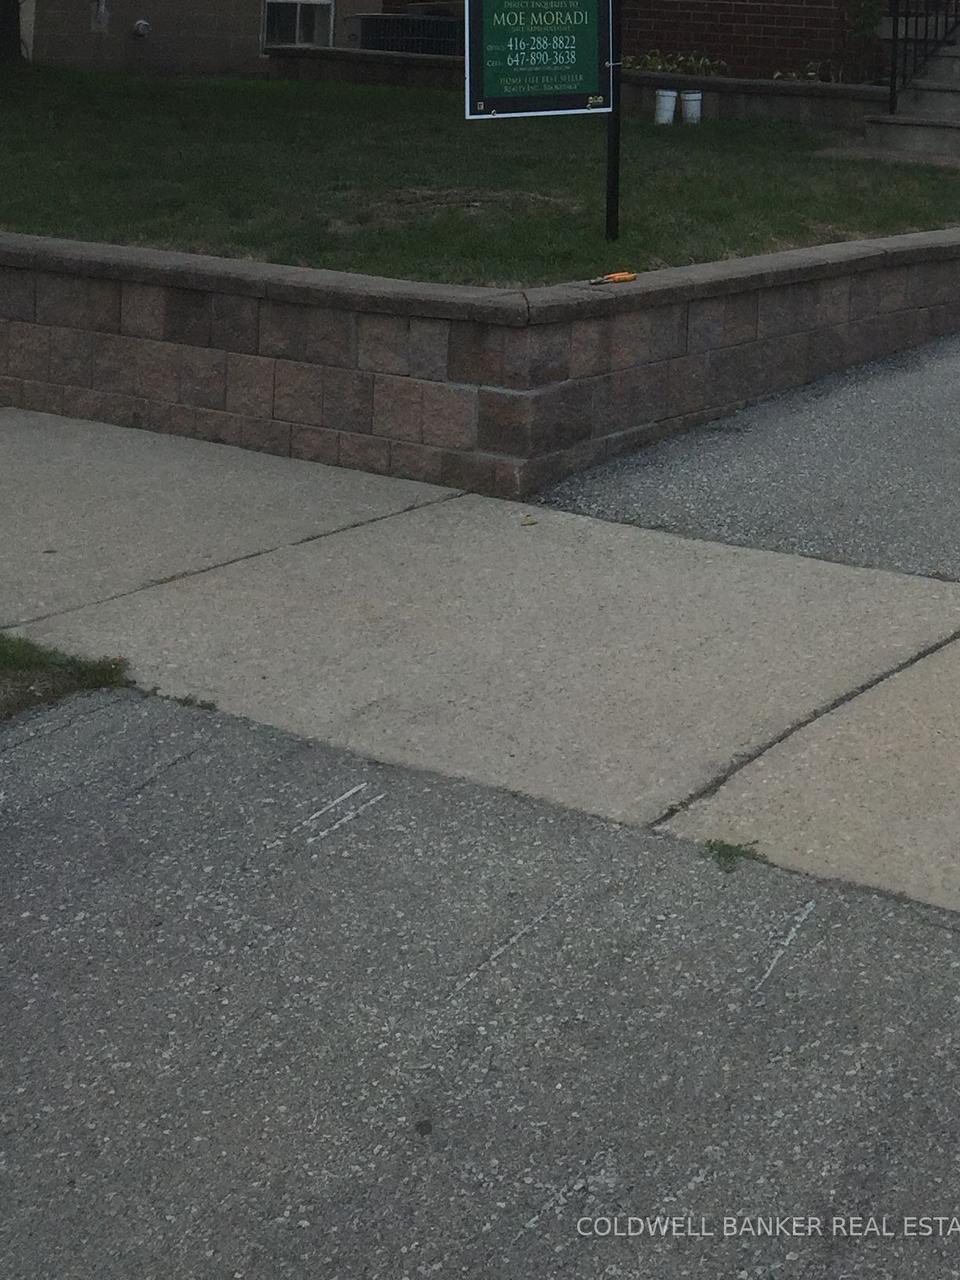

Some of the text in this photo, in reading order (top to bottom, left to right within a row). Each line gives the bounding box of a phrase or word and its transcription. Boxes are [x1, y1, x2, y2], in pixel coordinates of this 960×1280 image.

[493, 11, 588, 26] MOE MORADI
[507, 35, 576, 51] 416-288-8822
[507, 51, 576, 66] 647-890-3638
